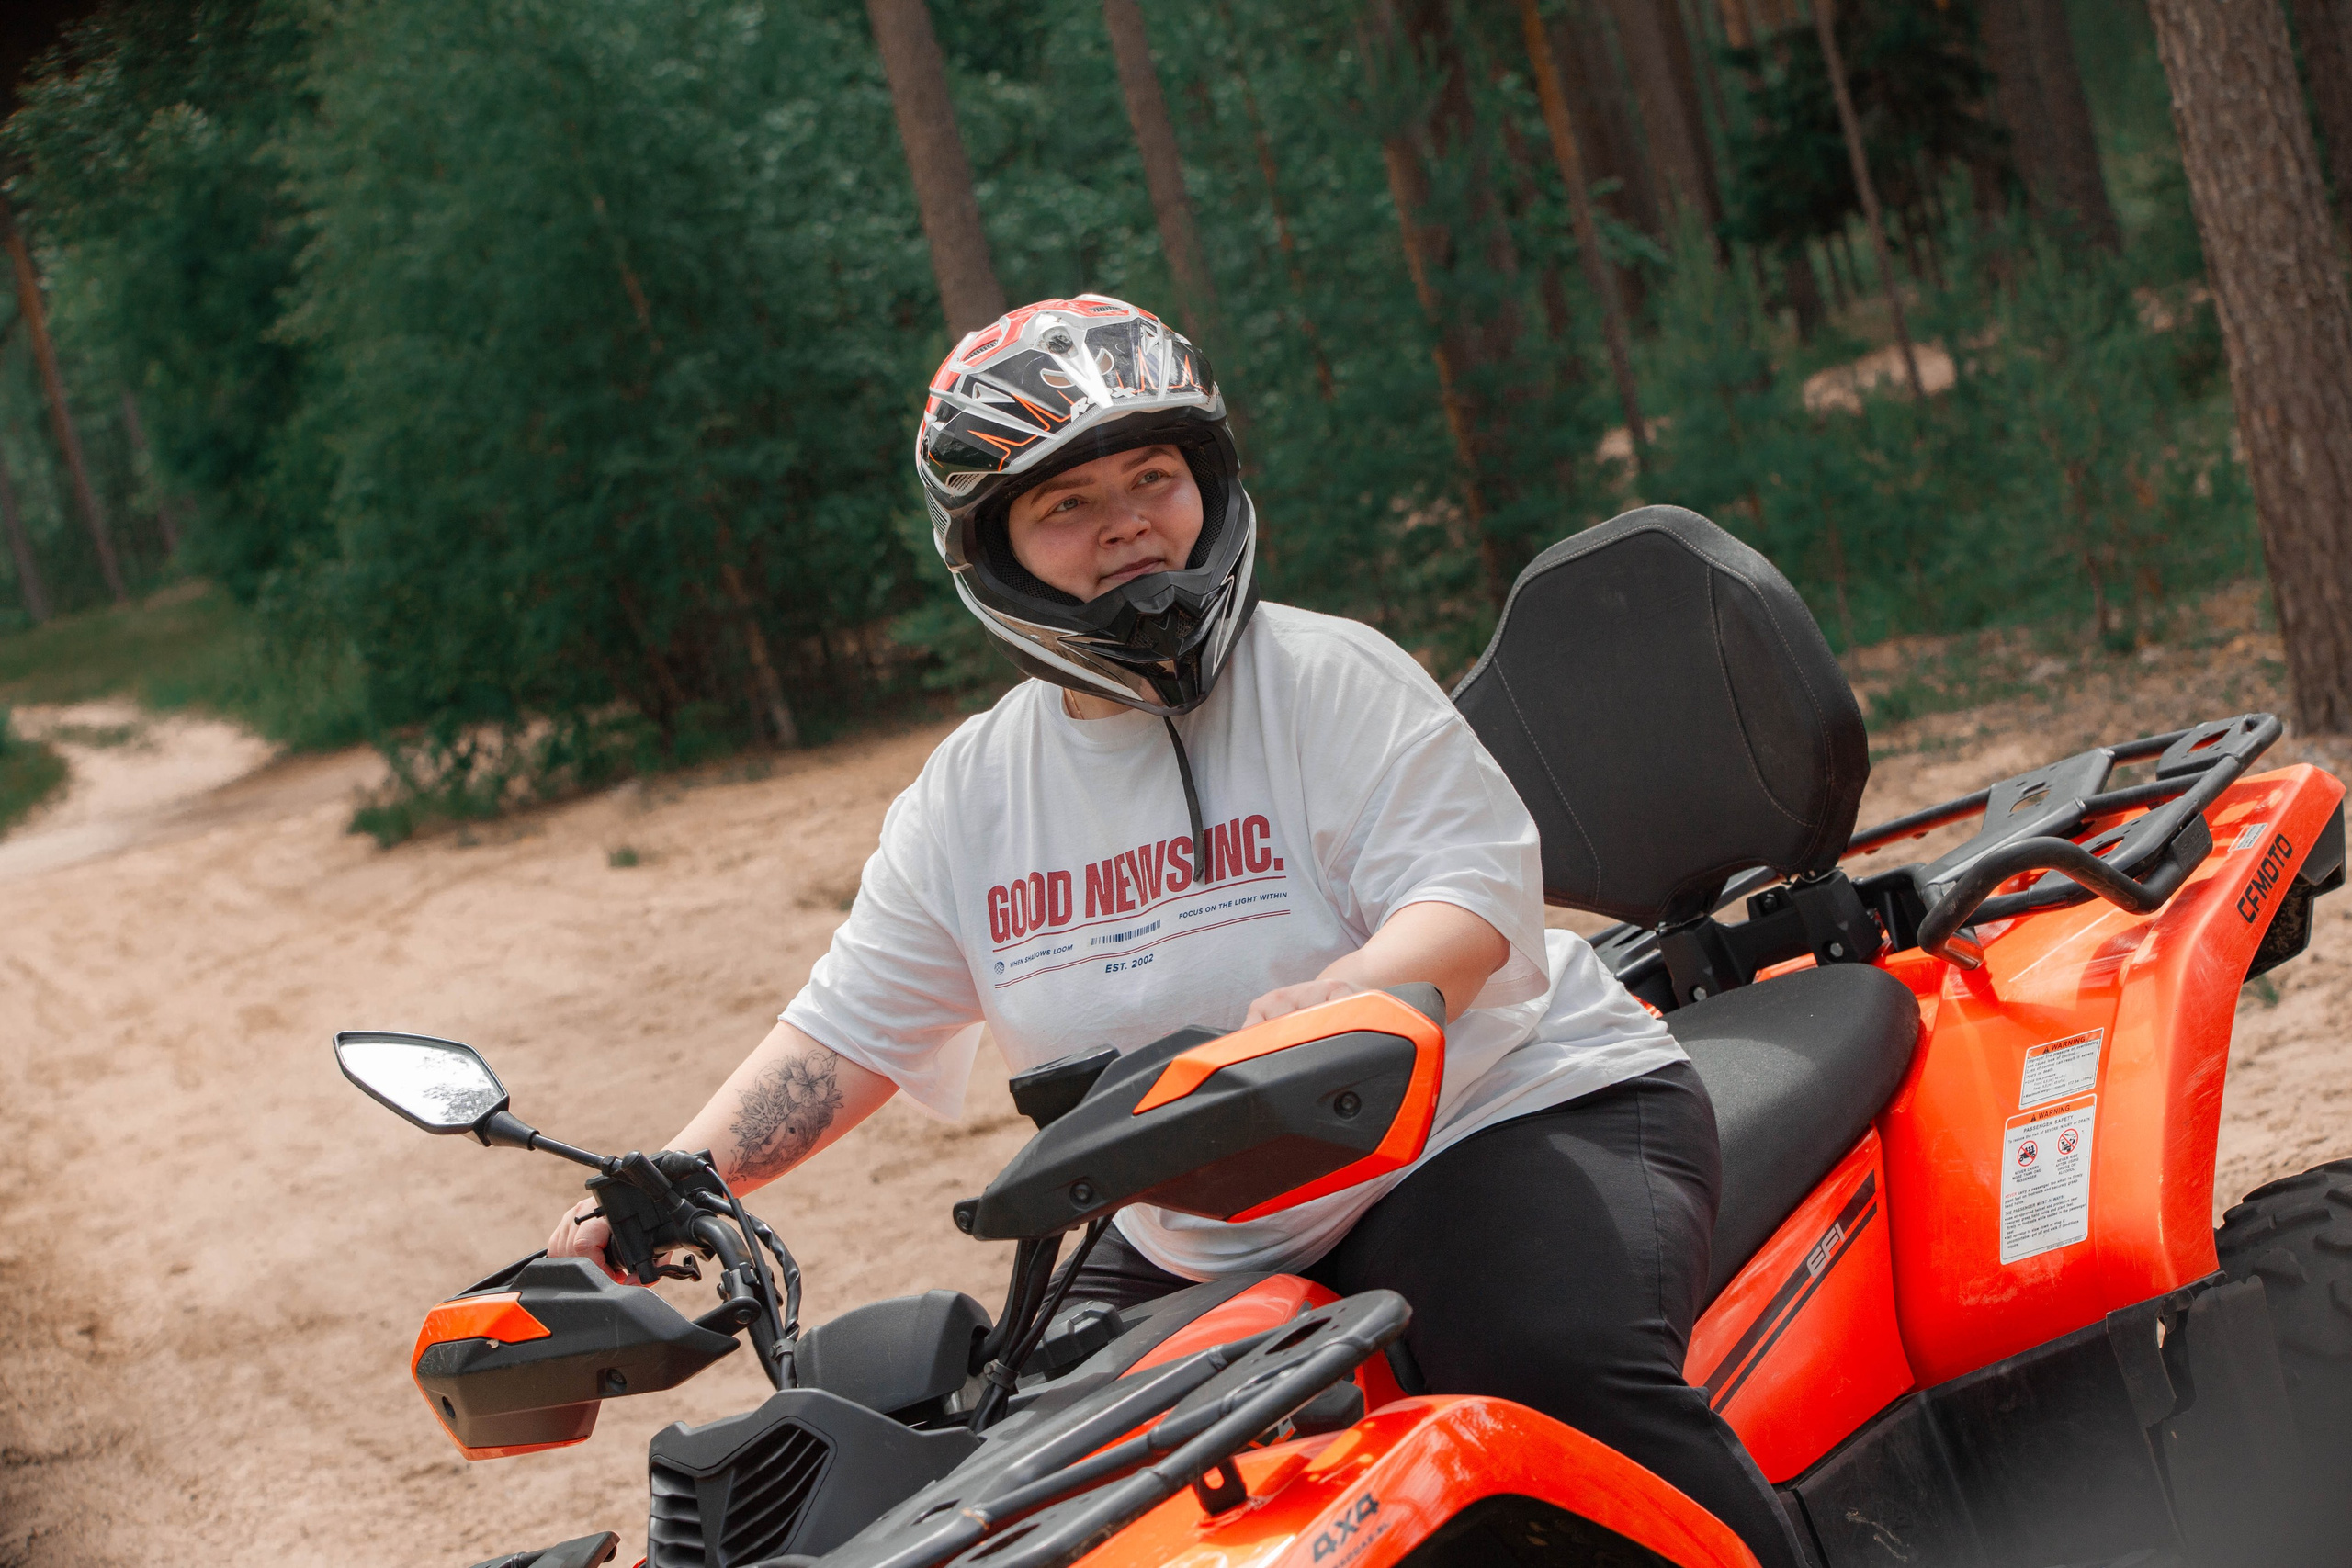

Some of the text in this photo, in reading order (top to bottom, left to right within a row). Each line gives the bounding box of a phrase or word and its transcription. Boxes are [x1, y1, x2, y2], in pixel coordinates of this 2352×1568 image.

[987, 814, 1284, 944] GOOD NEWS INC.
[2236, 833, 2293, 924] CFMOTO
[1178, 908, 1204, 919] FOCUS
[1218, 900, 1232, 909] THE
[1234, 896, 1257, 906] LIGHT
[1259, 892, 1287, 901] WITHIN
[1010, 944, 1073, 968] WHEN SHADOWS LOOM
[1105, 953, 1154, 973] EST. 2002
[2052, 1036, 2086, 1051] WARNING
[2024, 1115, 2074, 1133] PASSENGER SAFETY
[2038, 1105, 2070, 1120] WARNING
[1807, 1222, 1845, 1278] EFI
